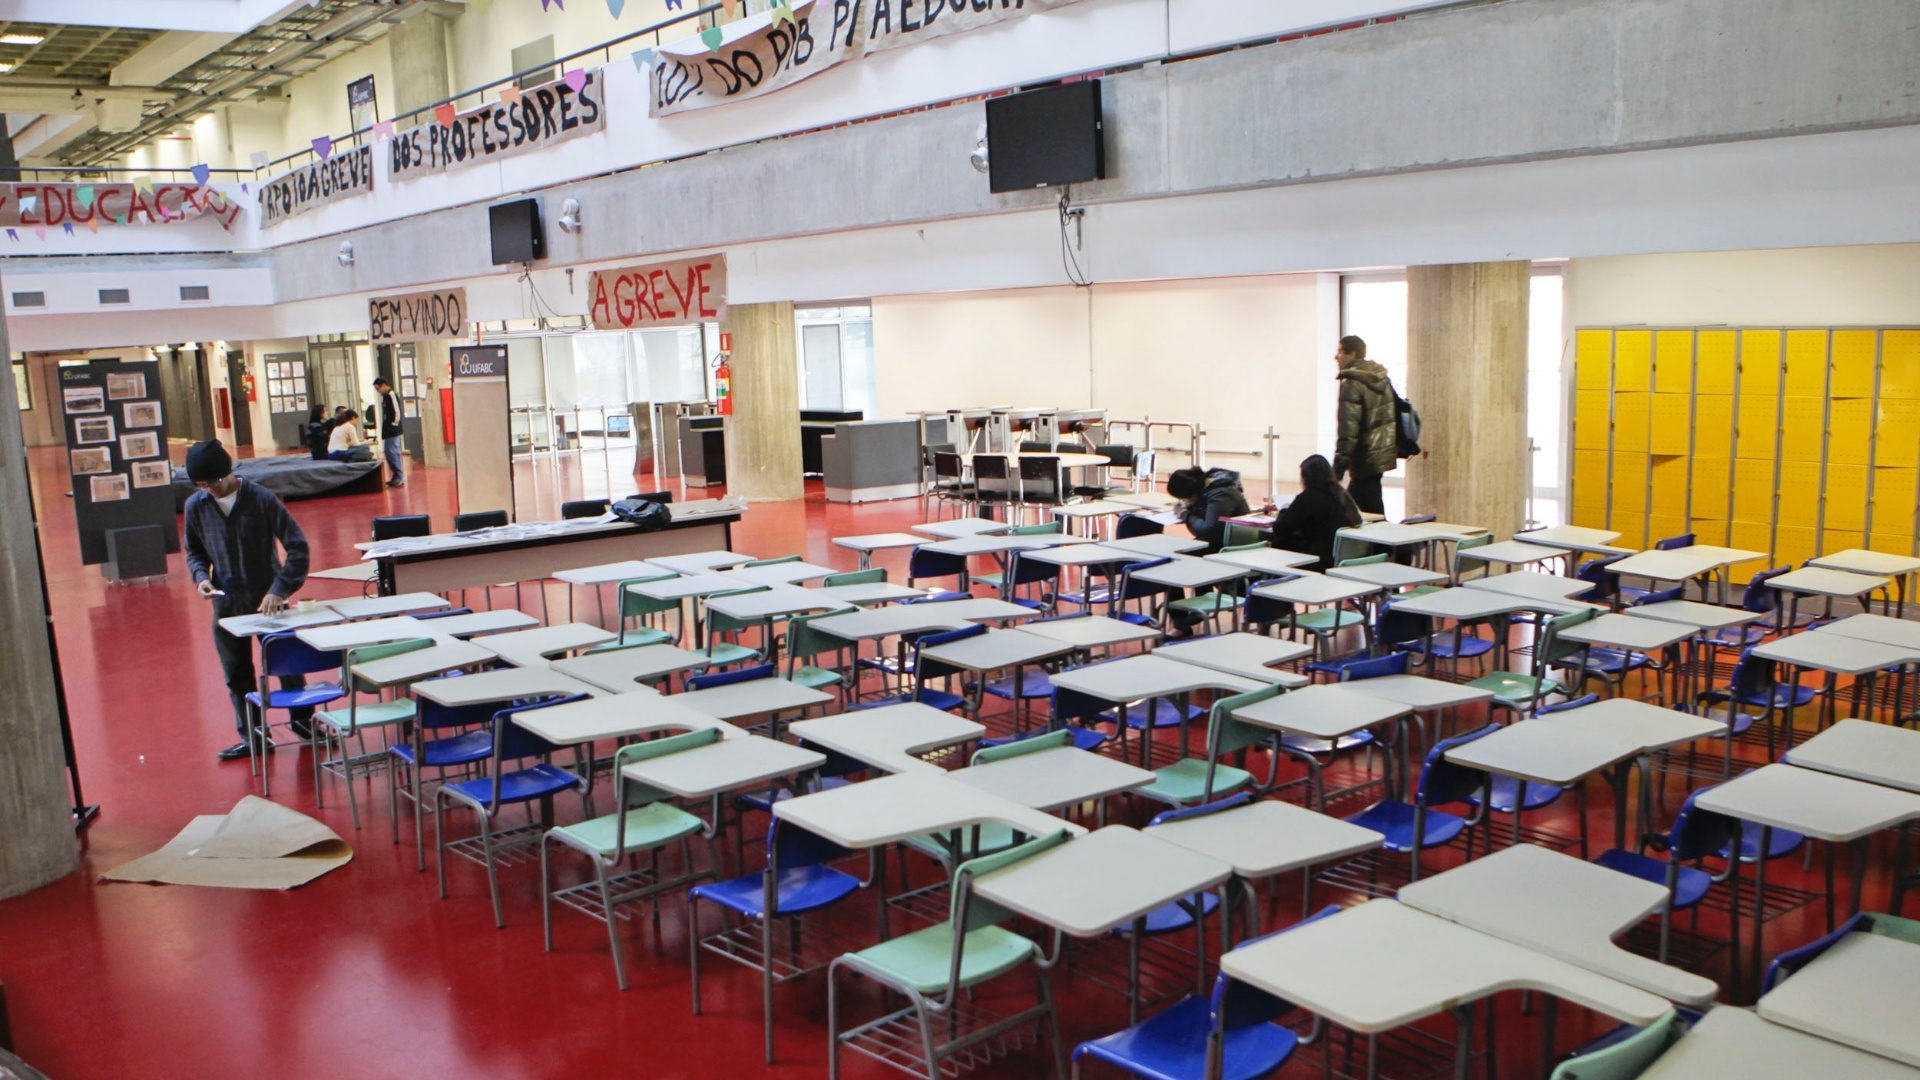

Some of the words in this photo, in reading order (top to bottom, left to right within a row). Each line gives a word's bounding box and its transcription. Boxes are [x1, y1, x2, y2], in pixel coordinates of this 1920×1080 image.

[706, 50, 764, 96] DO
[766, 17, 814, 77] PIB
[391, 129, 422, 173] DOS
[430, 73, 598, 168] PROFESSORES
[370, 293, 461, 340] BEM-VINDO
[613, 263, 717, 327] GREVE
[472, 362, 494, 374] UFABC
